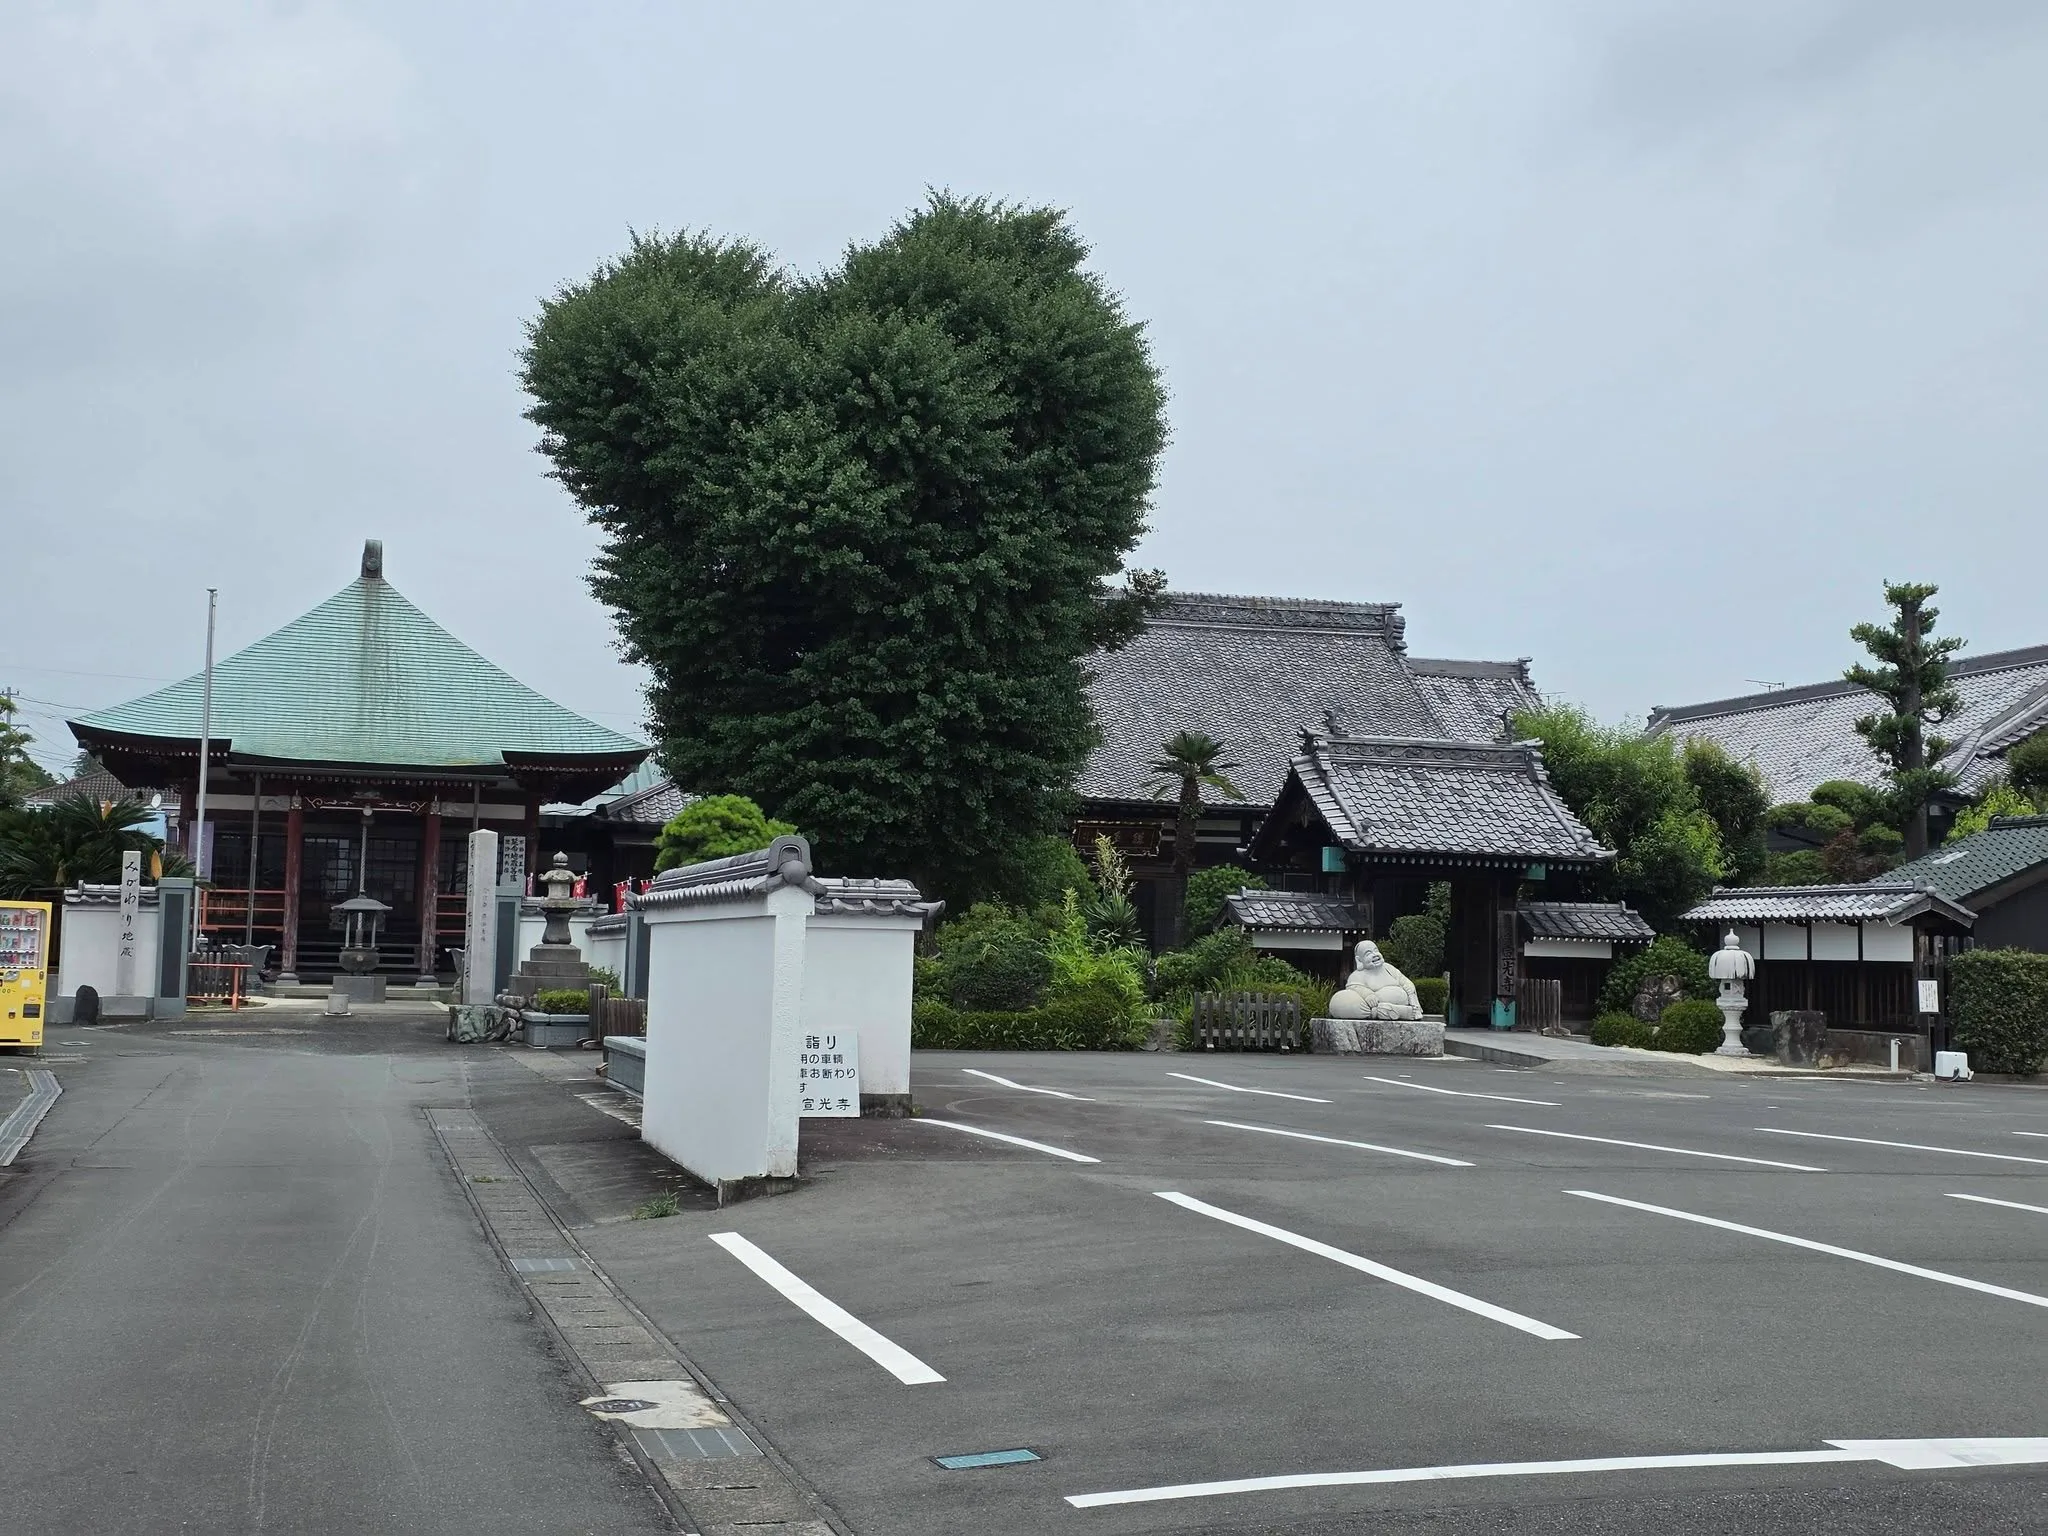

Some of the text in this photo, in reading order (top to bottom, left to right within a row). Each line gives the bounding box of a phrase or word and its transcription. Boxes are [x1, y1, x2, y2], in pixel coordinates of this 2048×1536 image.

[805, 1035, 836, 1050] 詣り
[802, 1098, 851, 1111] 宣光寺
